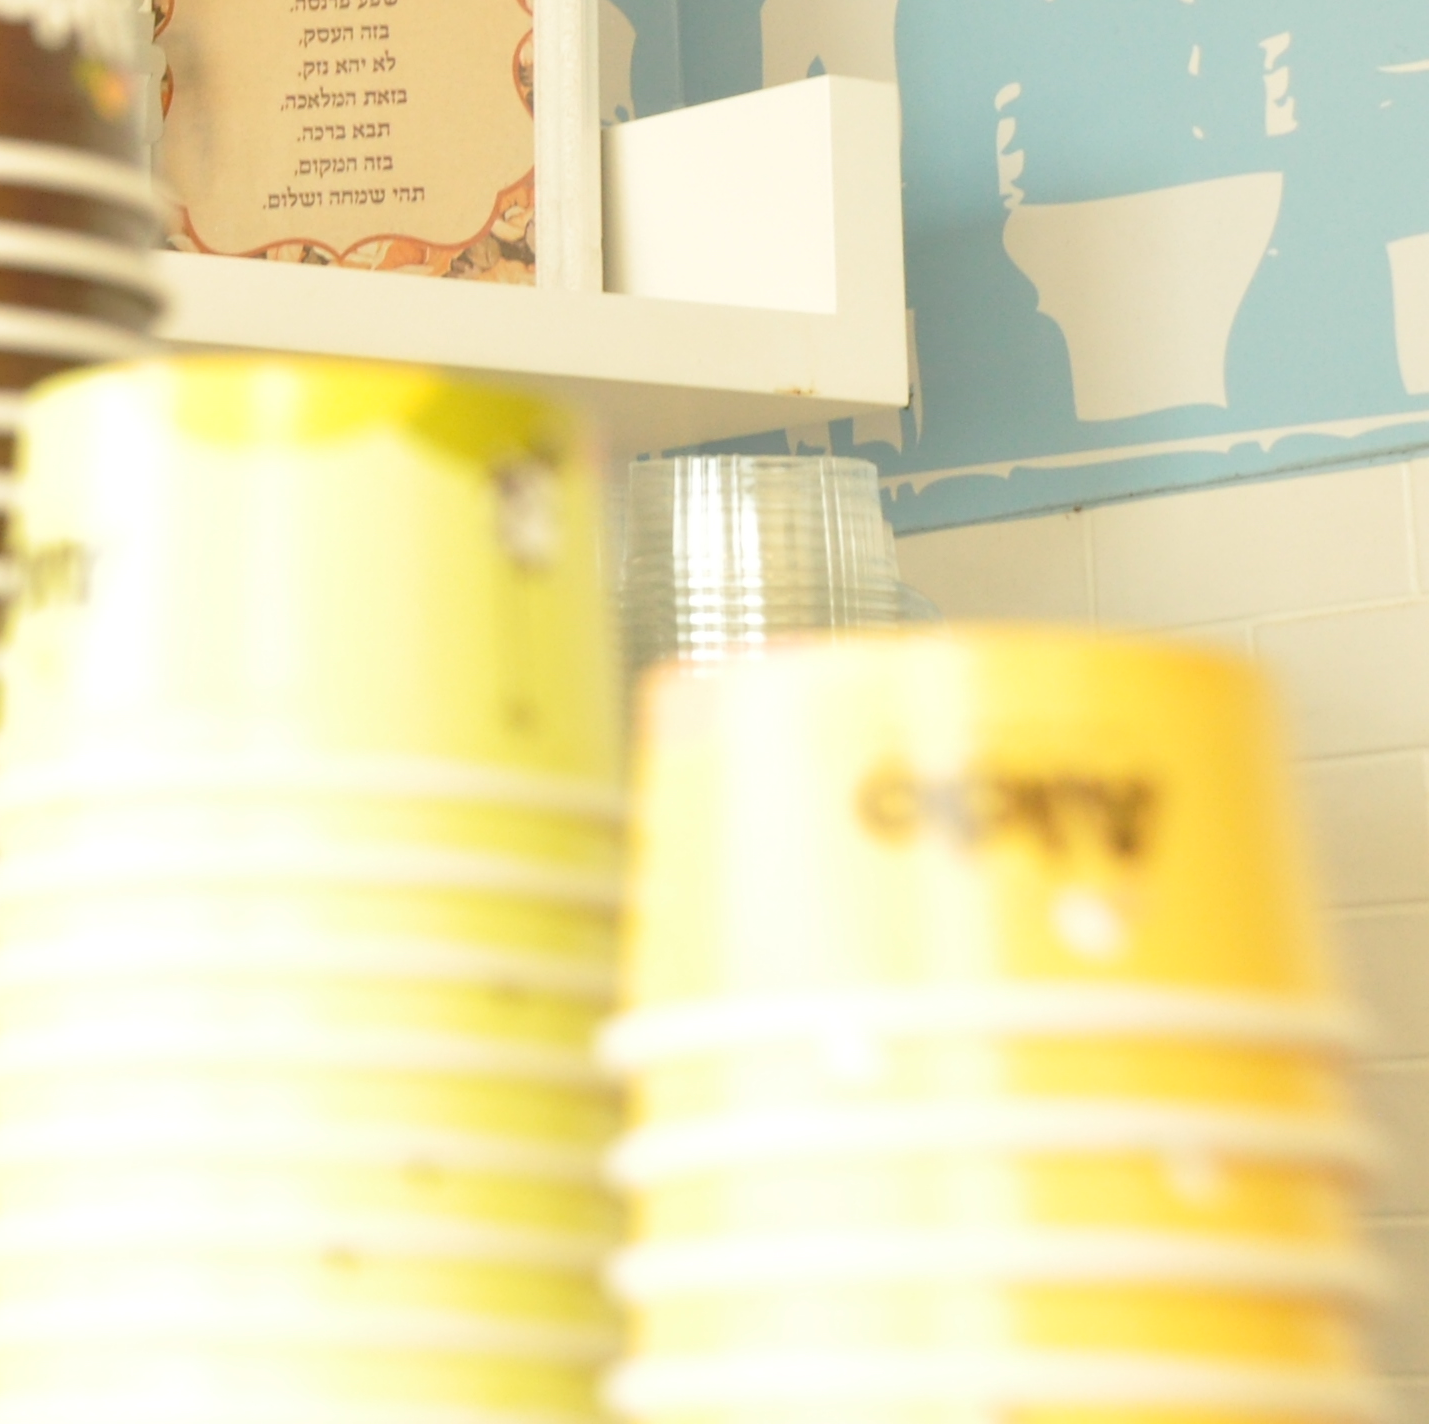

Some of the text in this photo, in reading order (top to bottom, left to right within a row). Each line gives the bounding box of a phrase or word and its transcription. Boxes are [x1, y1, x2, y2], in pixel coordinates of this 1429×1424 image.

[299, 24, 390, 48] בזה העסק,
[298, 50, 396, 81] לא יהא נזק.
[281, 86, 407, 111] בזאת המלאכה,
[297, 122, 391, 142] תבא ברכה.
[294, 155, 393, 179] בזה המקום,
[263, 186, 425, 209] תהי שמחה ושלום.
